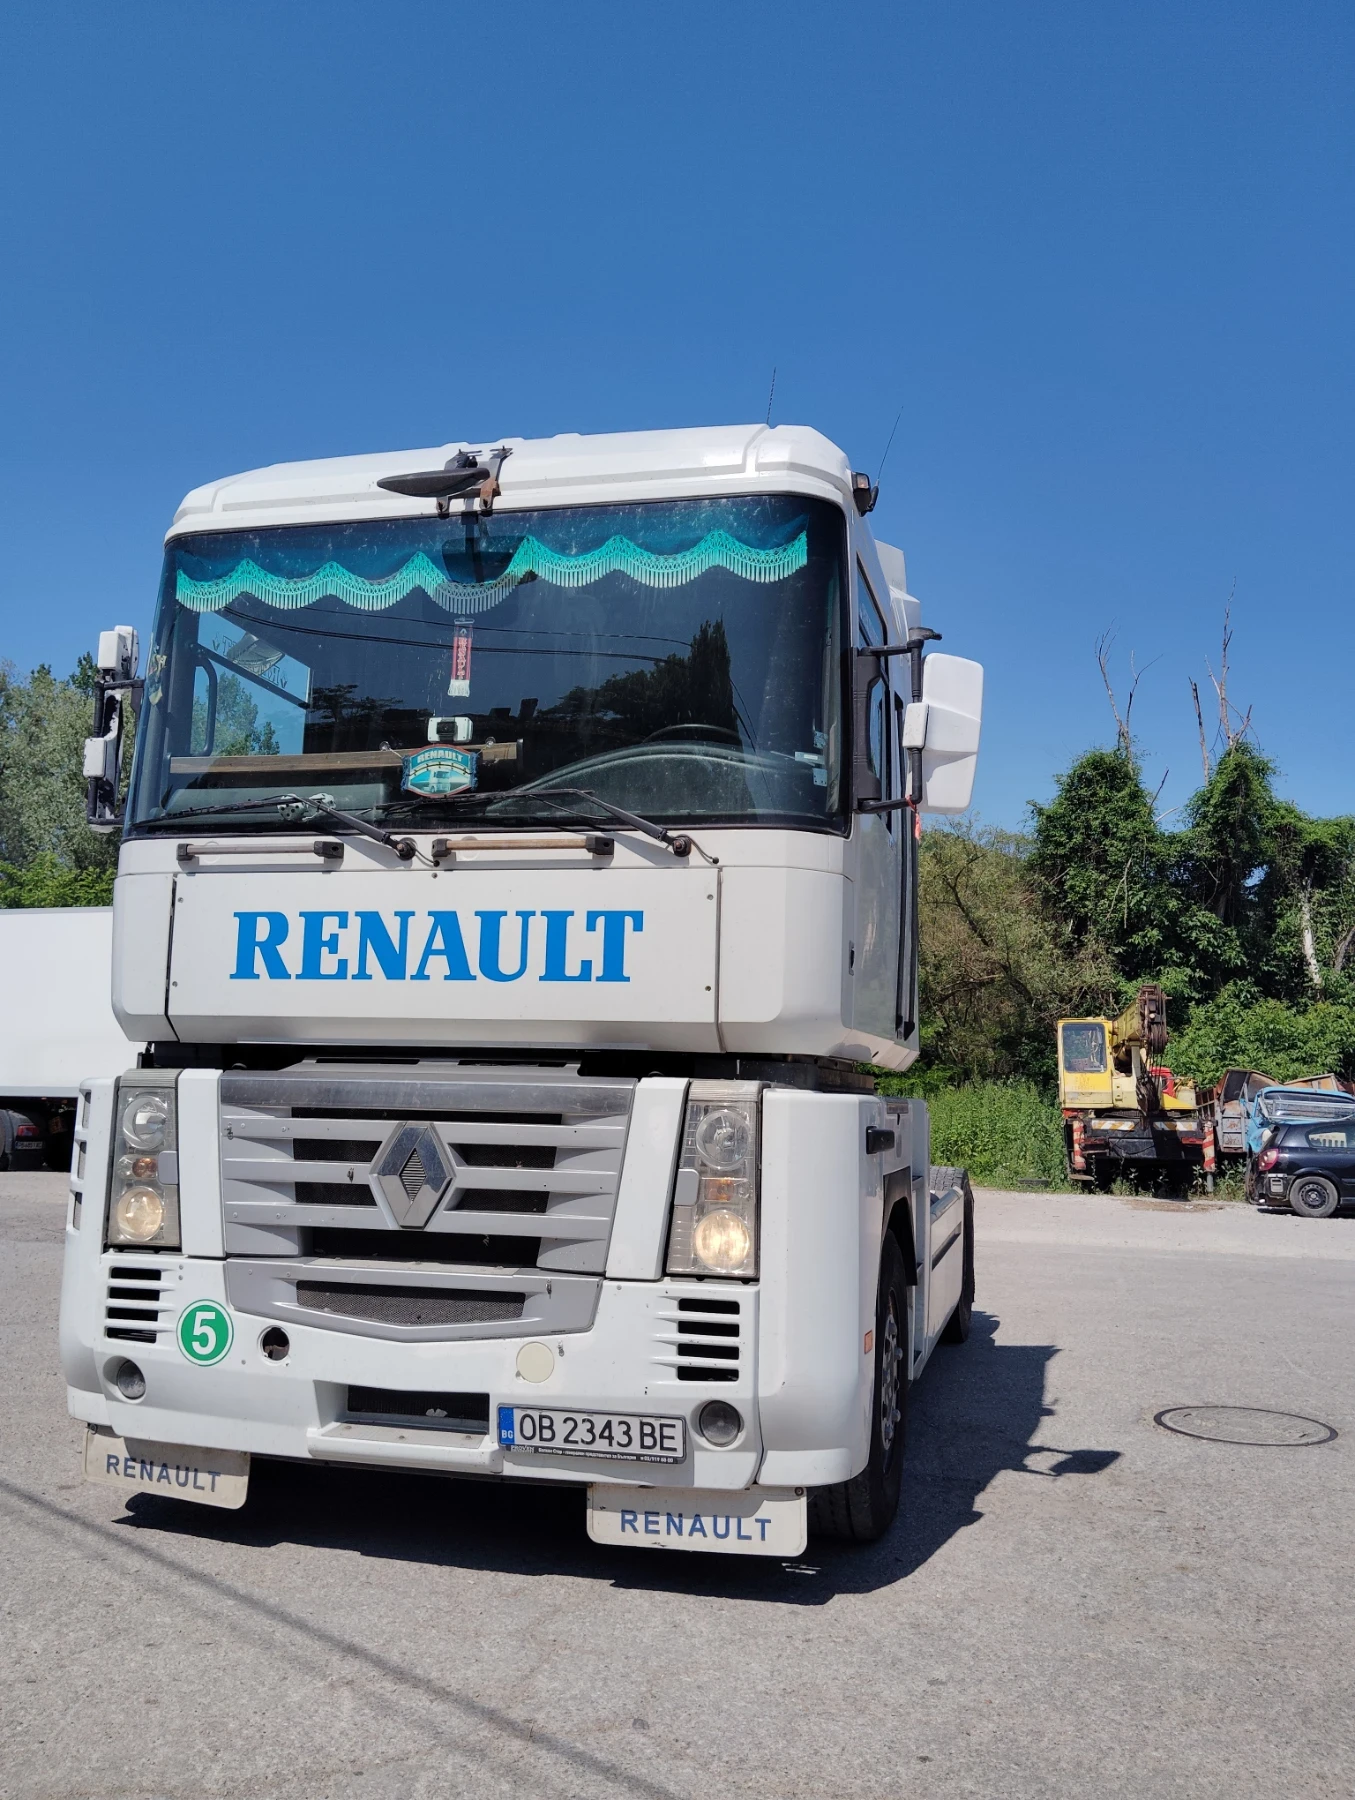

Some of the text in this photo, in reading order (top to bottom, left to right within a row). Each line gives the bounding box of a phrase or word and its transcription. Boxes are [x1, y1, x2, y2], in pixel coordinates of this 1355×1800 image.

[417, 750, 464, 763] RENAULT
[229, 910, 644, 983] RENAULT
[191, 1311, 217, 1355] 5
[501, 1413, 678, 1452] BG OB 2343 BE
[106, 1453, 222, 1493] RENAULT
[620, 1509, 772, 1542] RENAULT
